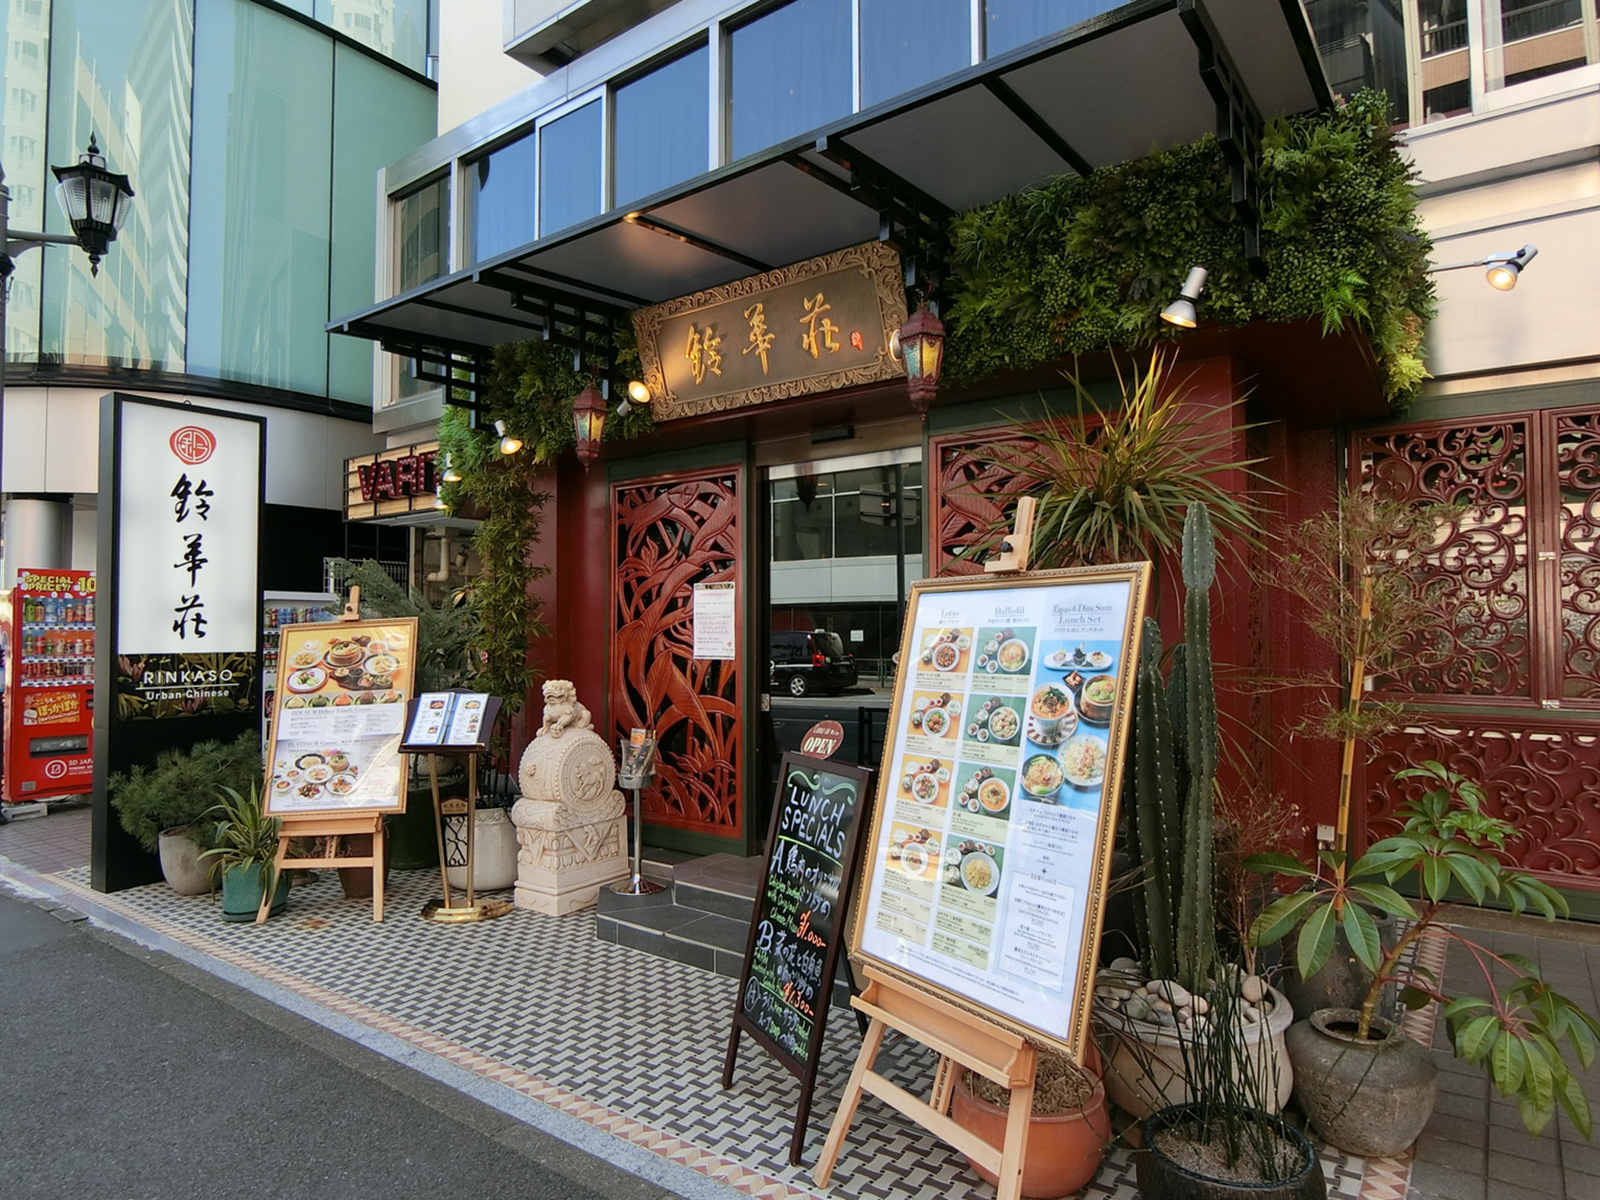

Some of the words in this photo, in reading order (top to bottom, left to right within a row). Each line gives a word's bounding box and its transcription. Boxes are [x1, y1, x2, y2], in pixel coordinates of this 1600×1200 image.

[25, 575, 73, 585] SPECIAL
[994, 606, 1026, 616] Daffodil
[1052, 605, 1071, 614] Tapas
[1078, 604, 1094, 612] Dim
[1095, 604, 1113, 612] Sum
[1059, 615, 1086, 624] Lunch
[1087, 615, 1102, 623] Set
[143, 669, 233, 684] RINKASO
[145, 691, 182, 700] Urban
[185, 689, 230, 698] Chinese
[804, 737, 836, 754] OPEN
[791, 785, 845, 826] LUNCH
[782, 806, 846, 858] SPECIALS
